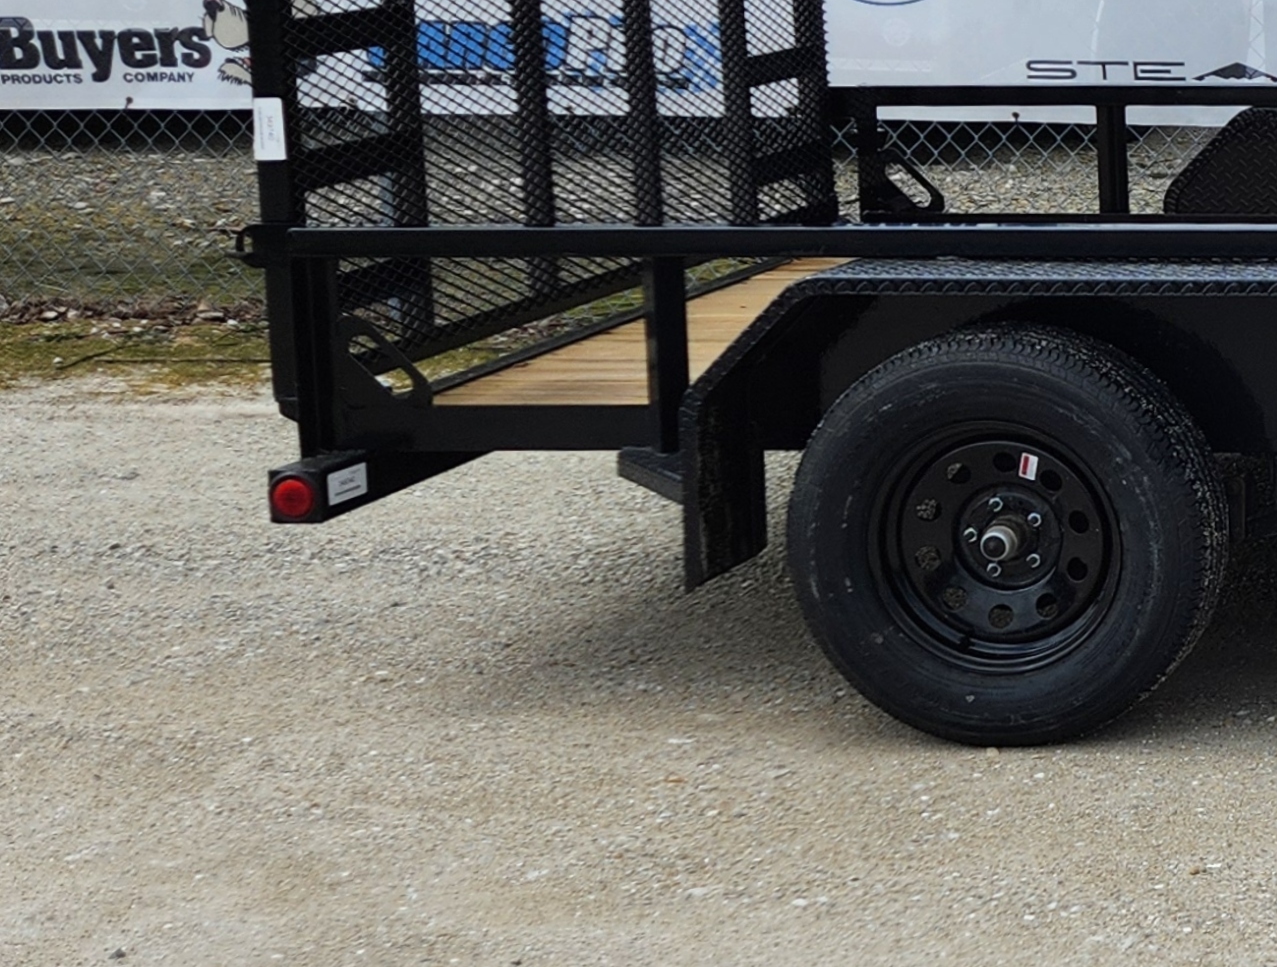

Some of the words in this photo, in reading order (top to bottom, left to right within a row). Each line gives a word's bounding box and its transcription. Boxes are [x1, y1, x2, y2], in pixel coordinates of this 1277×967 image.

[0, 16, 212, 83] Buyers
[1, 73, 83, 84] PRODUCTS
[123, 72, 195, 83] COMPANY
